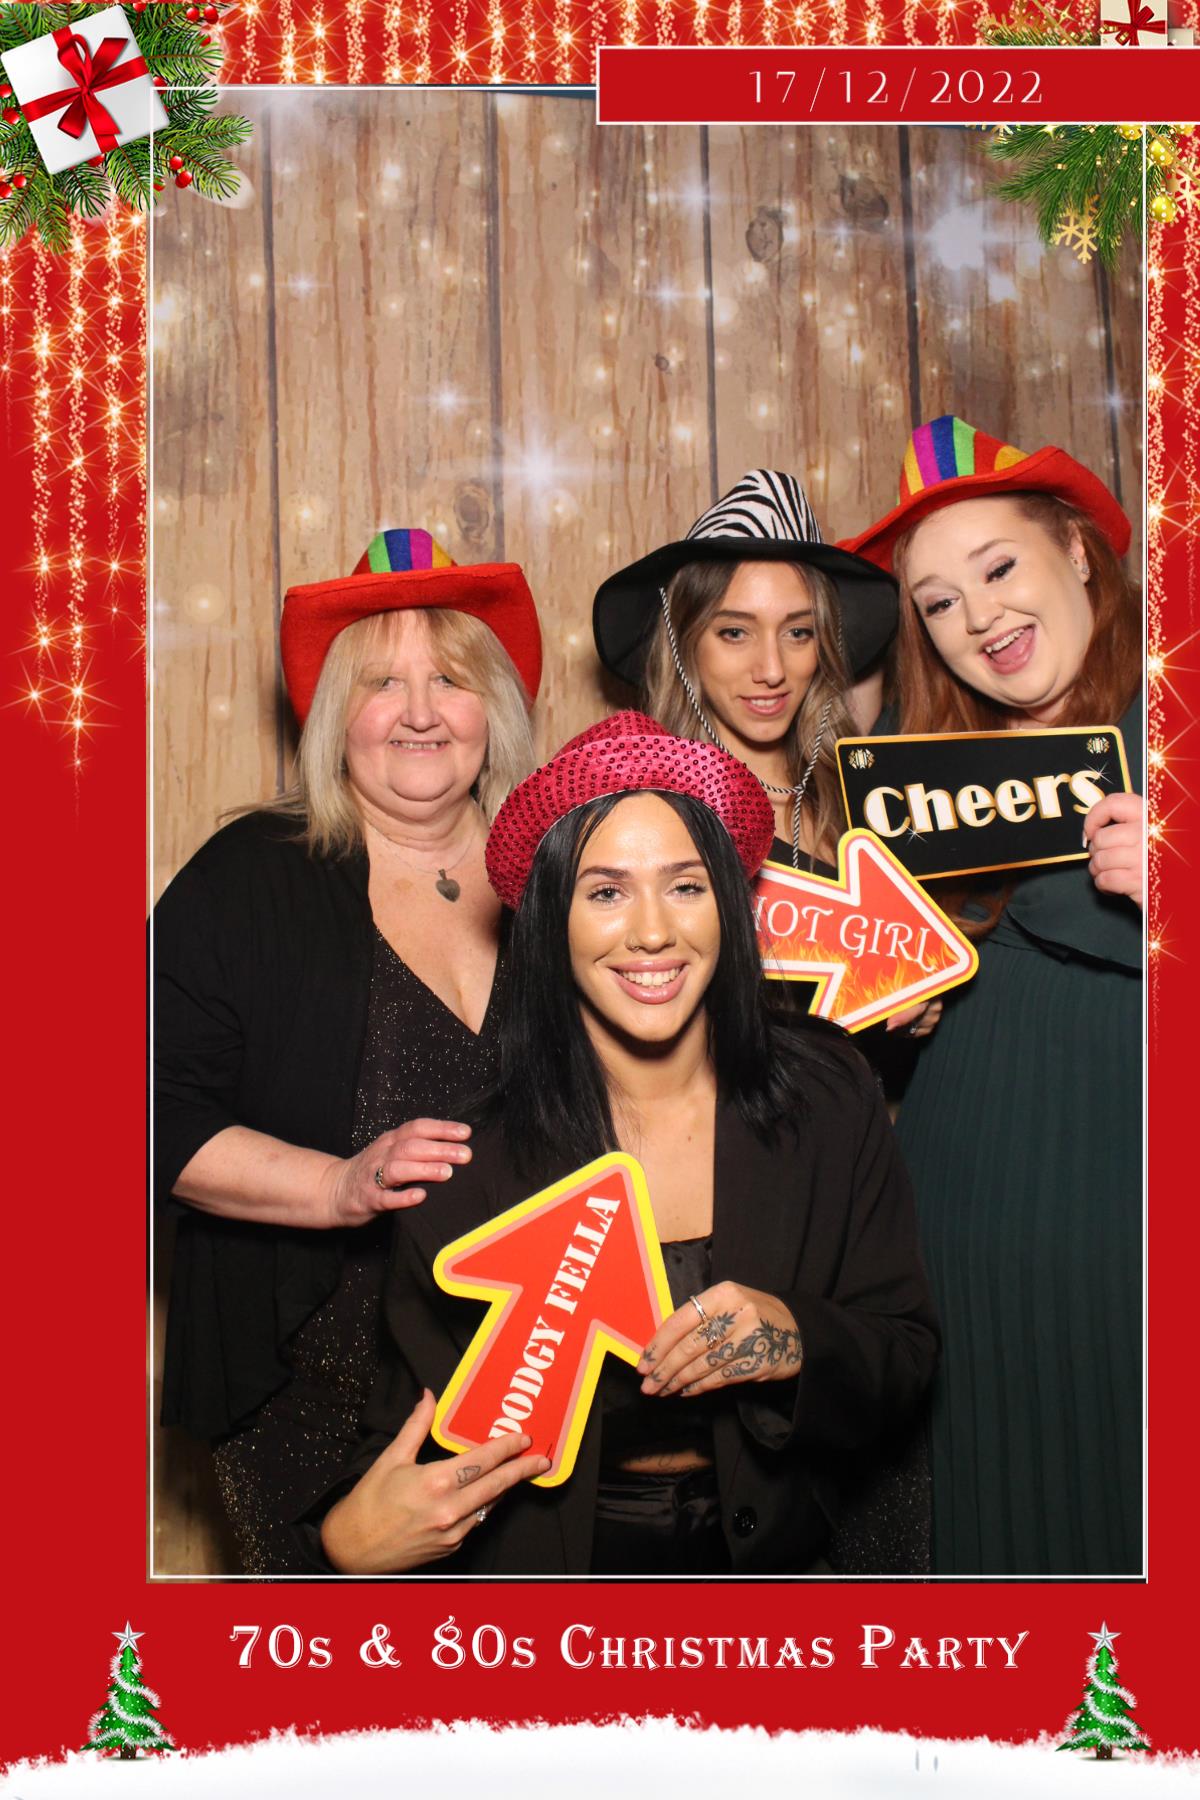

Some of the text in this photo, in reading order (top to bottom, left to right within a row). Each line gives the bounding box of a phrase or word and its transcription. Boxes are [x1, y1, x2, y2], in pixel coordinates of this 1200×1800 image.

[863, 770, 1106, 838] Cheers
[839, 914, 937, 972] GIRL
[544, 1195, 621, 1315] FELLA
